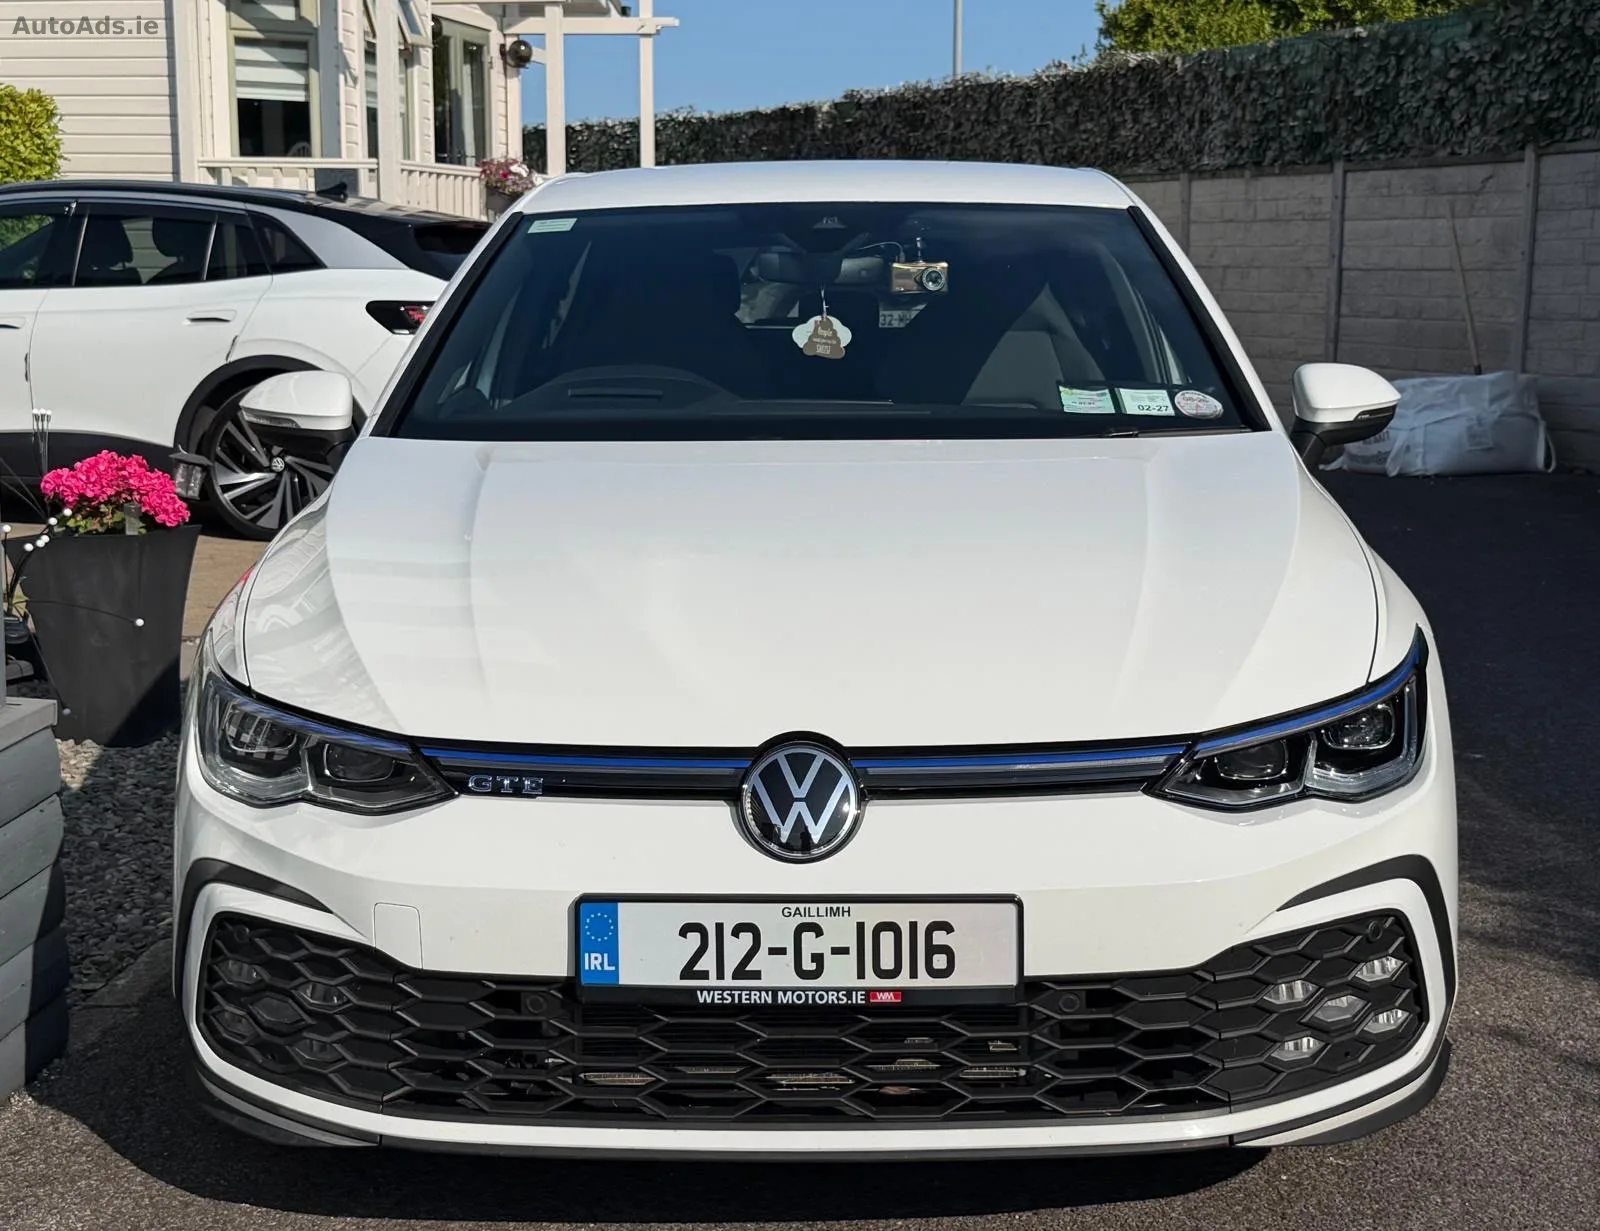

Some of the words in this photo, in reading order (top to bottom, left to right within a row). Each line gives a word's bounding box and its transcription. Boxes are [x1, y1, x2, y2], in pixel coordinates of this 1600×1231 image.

[1137, 404, 1169, 412] 02-27
[468, 774, 544, 795] GTE
[781, 906, 851, 918] GAILLIMH
[678, 920, 956, 981] 212-G-1016
[584, 952, 616, 971] IRL
[697, 990, 772, 1004] WESTERN
[777, 990, 866, 1004] MOTORS.IE
